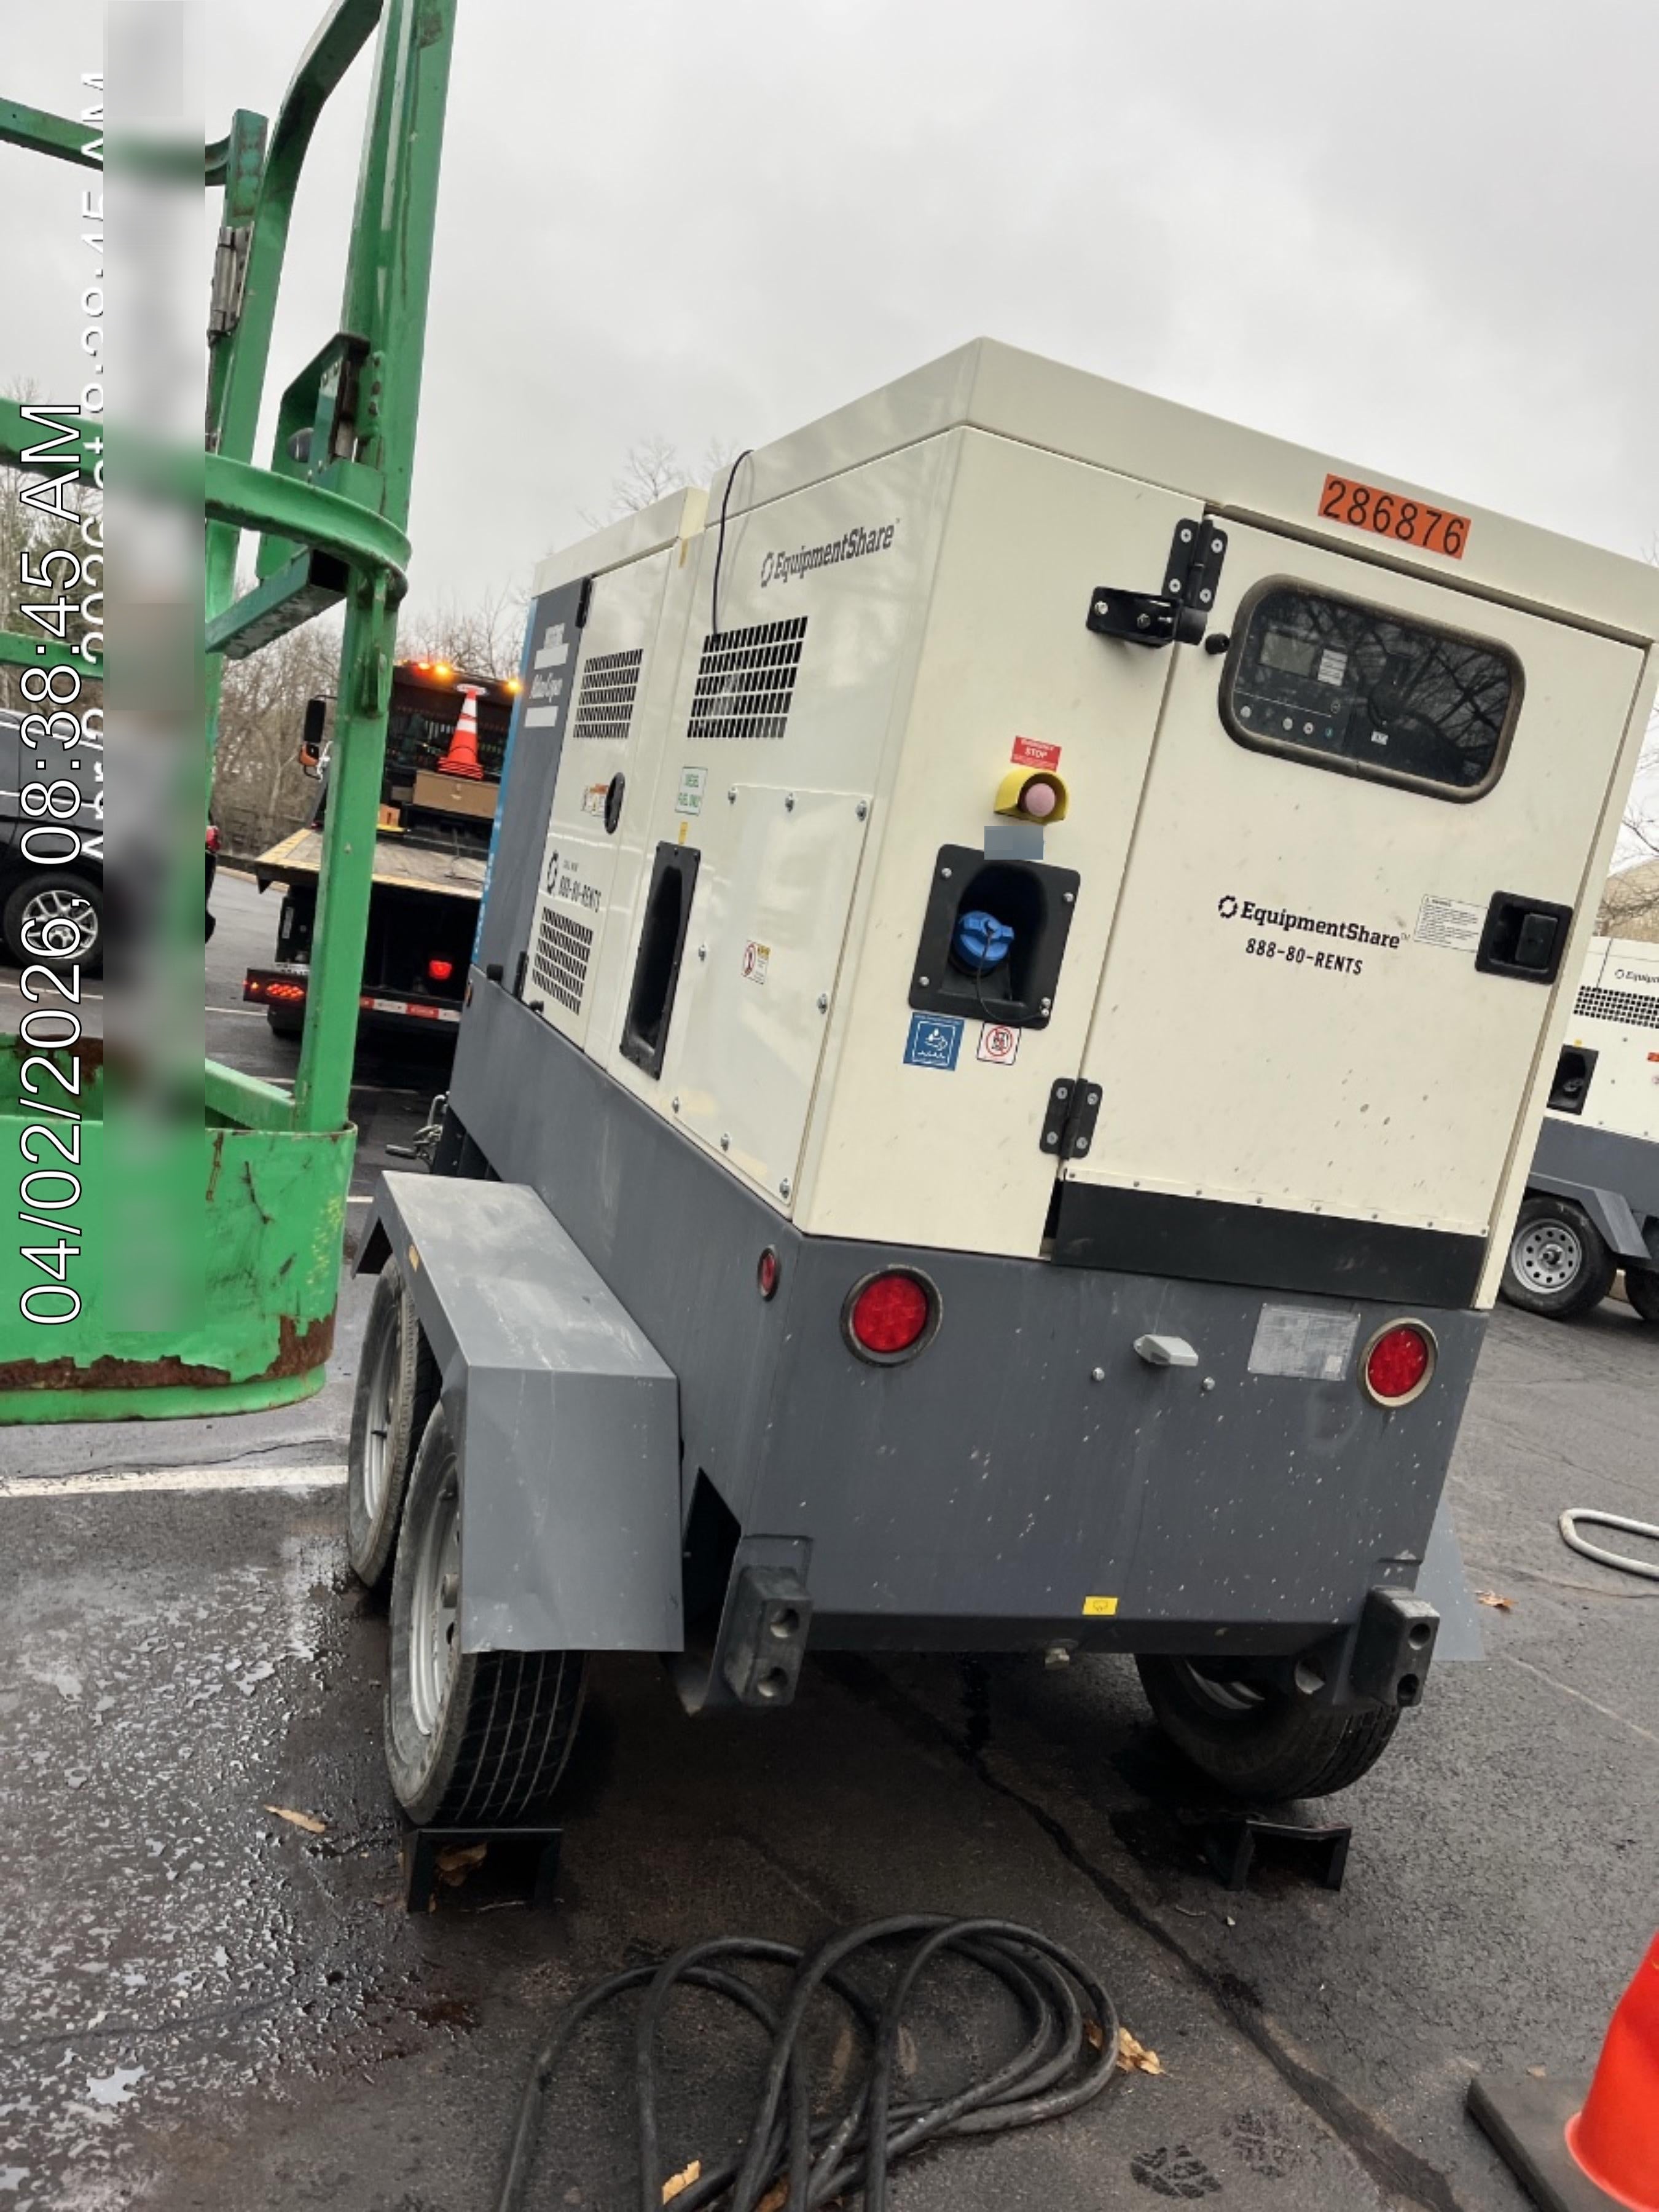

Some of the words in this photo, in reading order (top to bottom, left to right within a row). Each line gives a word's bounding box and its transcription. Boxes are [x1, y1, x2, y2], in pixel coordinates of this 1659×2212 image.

[1322, 479, 1465, 556] 286876
[773, 524, 895, 583] EquipmentShare
[1024, 746, 1048, 759] STOP
[1240, 901, 1401, 949] EquipmentShare
[1245, 937, 1363, 976] 888-80-RENTS
